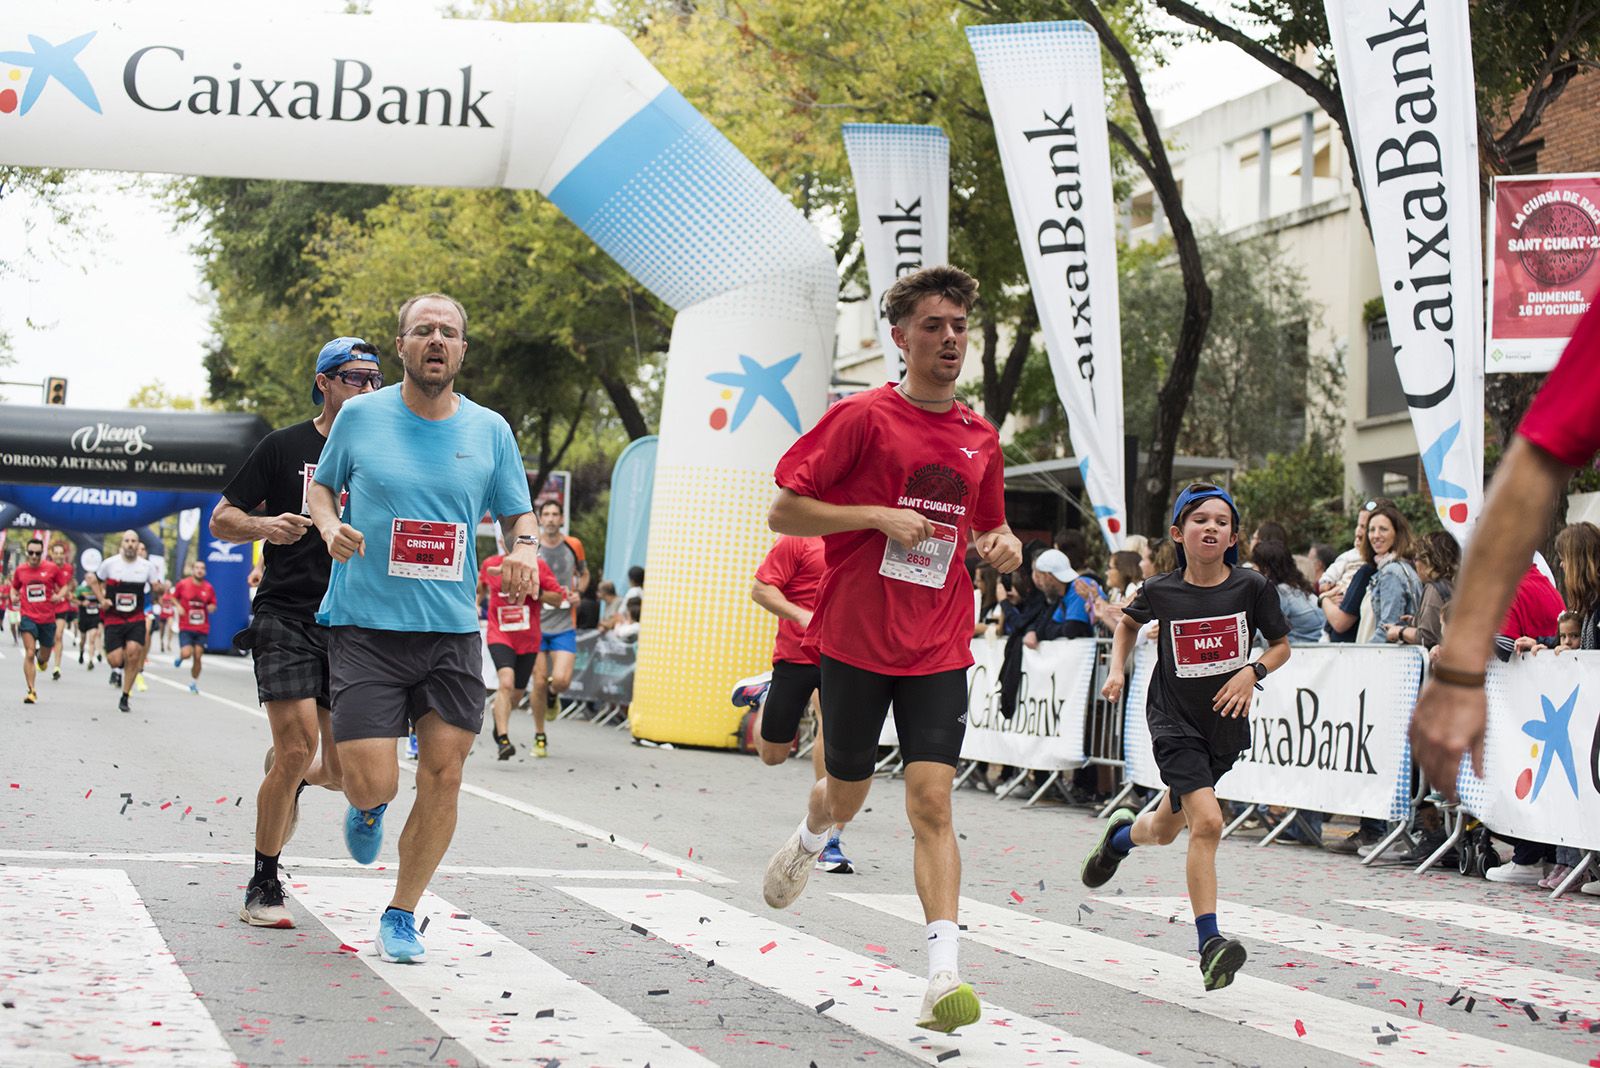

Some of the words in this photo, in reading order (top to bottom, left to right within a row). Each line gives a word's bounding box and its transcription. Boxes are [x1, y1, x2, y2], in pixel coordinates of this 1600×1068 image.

[122, 45, 495, 128] CaixaBank
[1511, 212, 1527, 231] LA
[1522, 190, 1561, 216] CURSA
[1562, 190, 1580, 205] DE
[1507, 237, 1543, 252] SANT
[1543, 236, 1586, 251] CUGAT
[1023, 104, 1097, 415] aixaBank
[1527, 290, 1585, 304] DIUMENGE,
[1518, 304, 1533, 317] 16
[60, 456, 128, 472] ARTESANS
[134, 460, 226, 477] D'AGRAMUNT
[897, 496, 922, 508] SANT
[923, 499, 952, 514] CUGAT
[406, 539, 445, 550] CRISTIAN
[416, 553, 435, 563] 825
[907, 553, 931, 567] 2630
[1194, 636, 1223, 650] MAX
[1200, 651, 1220, 661] 635
[1238, 687, 1378, 775] ixaBank
